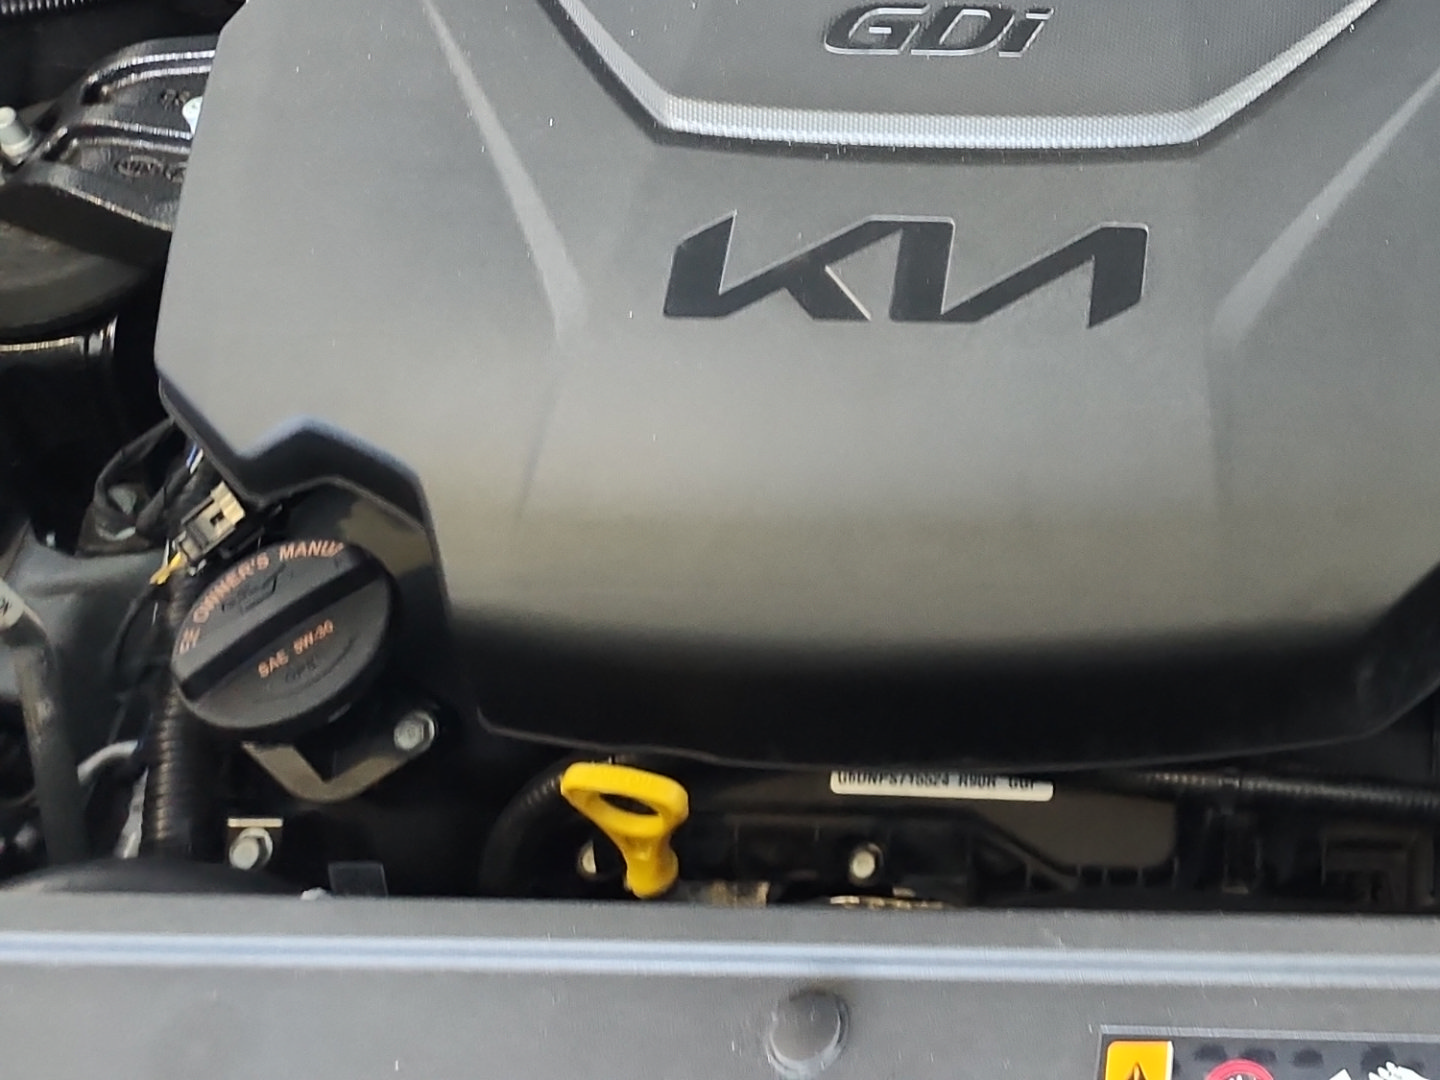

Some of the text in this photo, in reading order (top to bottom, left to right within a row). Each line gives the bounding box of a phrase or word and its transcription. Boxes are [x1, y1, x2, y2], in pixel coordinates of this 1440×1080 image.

[823, 1, 1056, 59] GDi
[663, 208, 1150, 330] KIA
[257, 648, 289, 678] SAE
